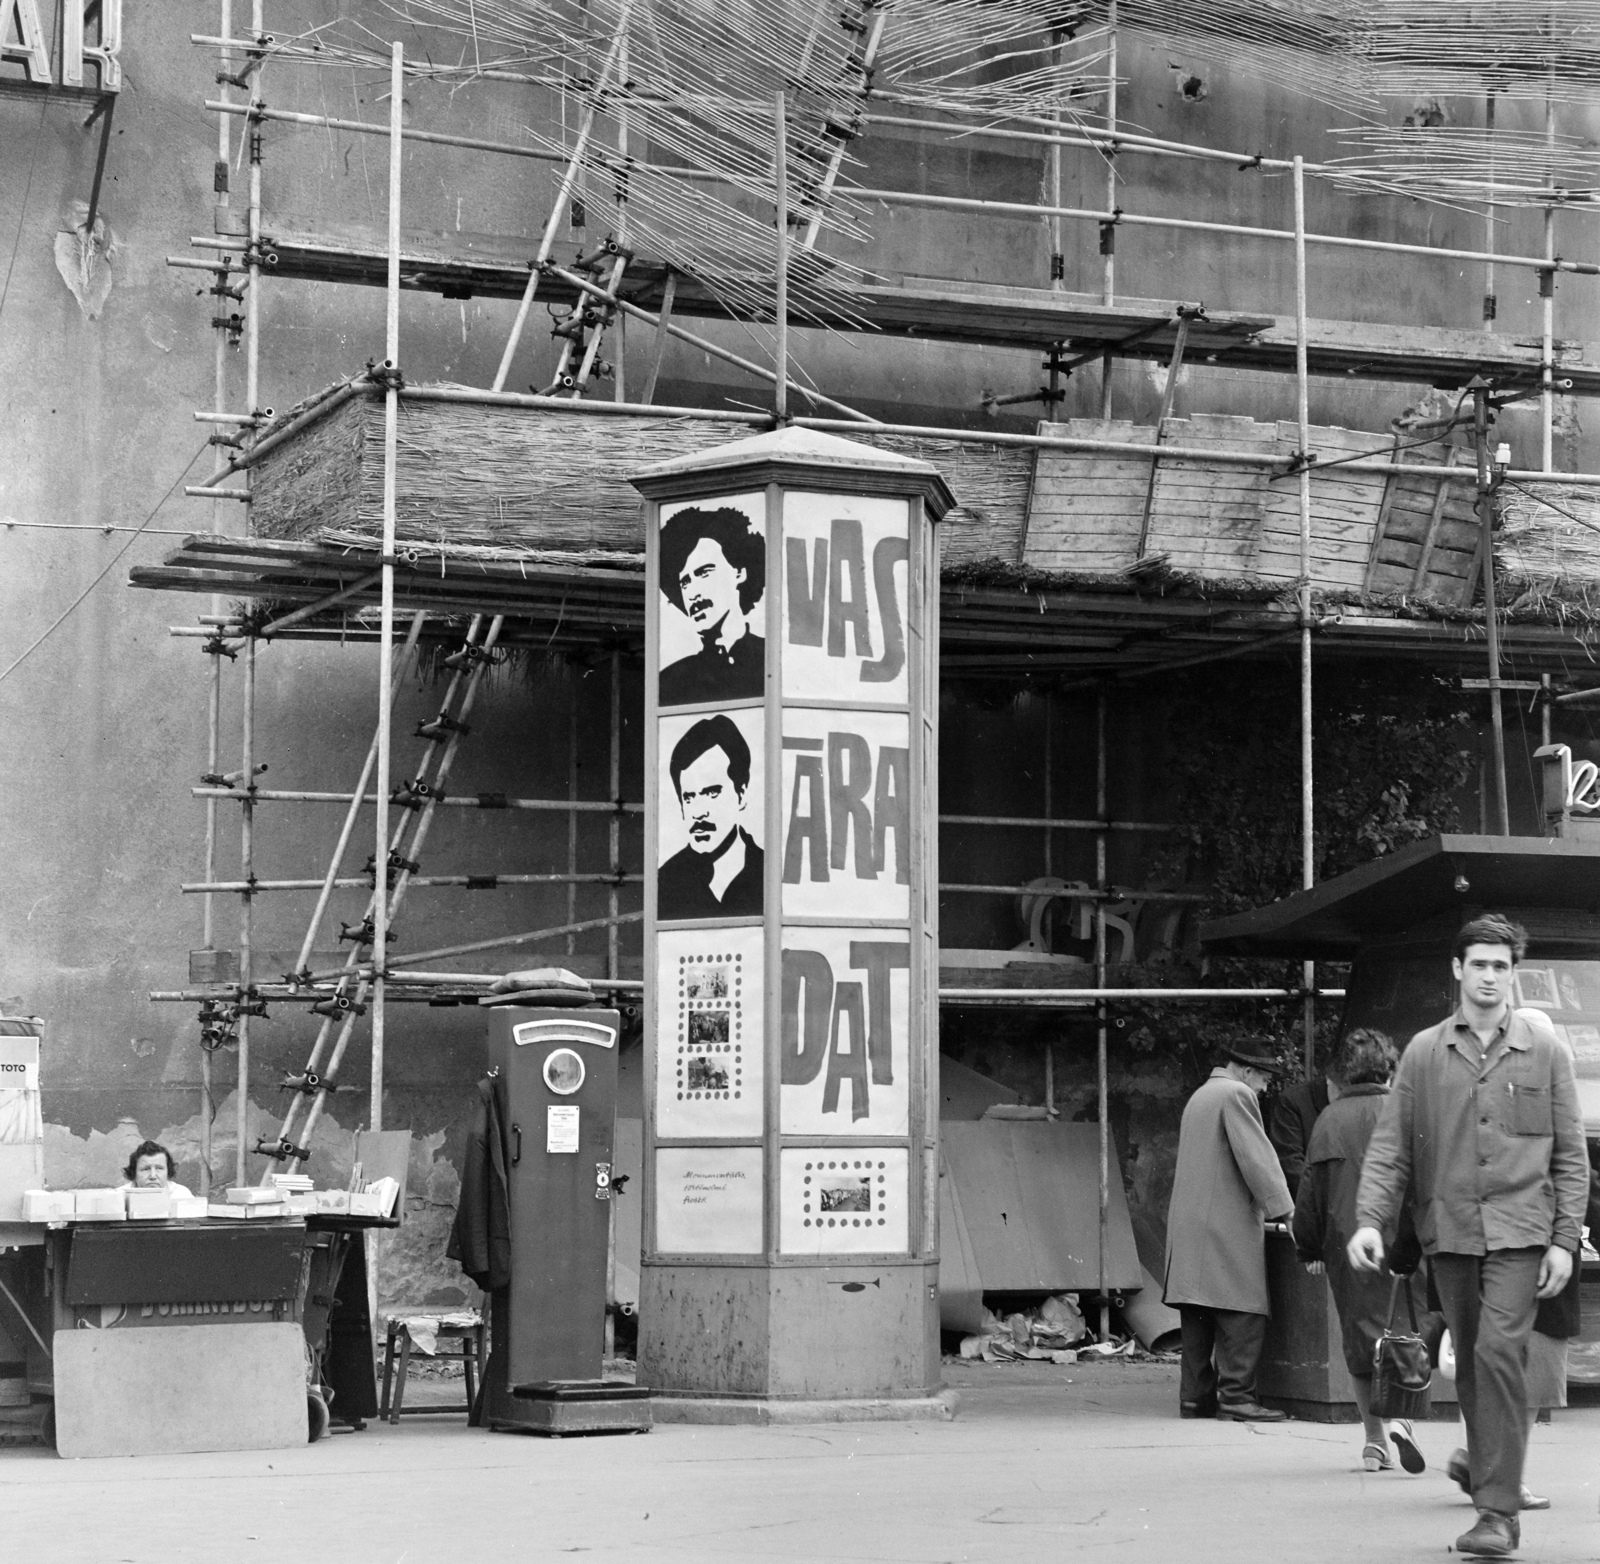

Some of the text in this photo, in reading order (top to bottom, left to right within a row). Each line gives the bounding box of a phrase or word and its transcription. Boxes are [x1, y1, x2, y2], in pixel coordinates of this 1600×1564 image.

[786, 519, 909, 682] VAS
[0, 1064, 26, 1073] TOTO
[781, 941, 909, 1123] DAT
